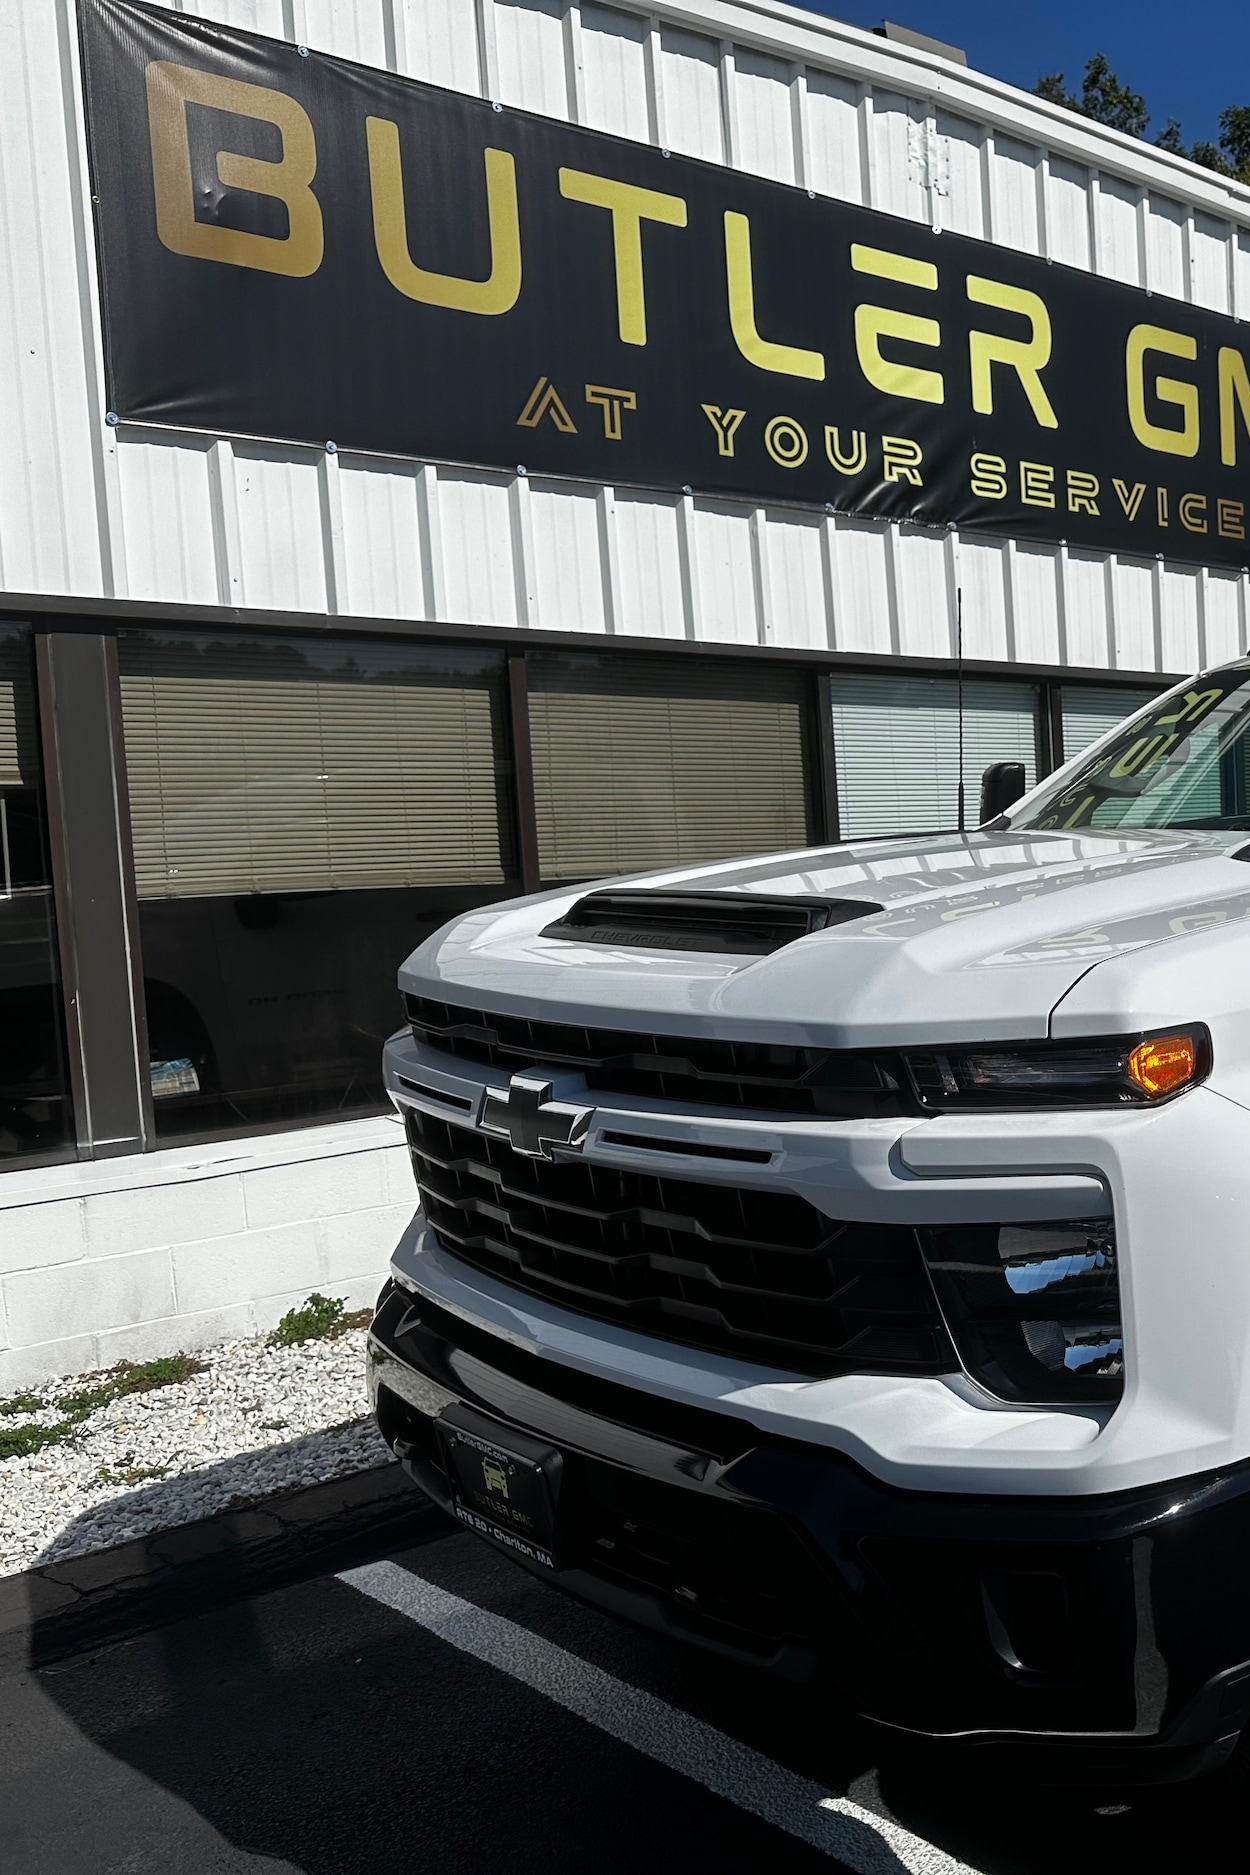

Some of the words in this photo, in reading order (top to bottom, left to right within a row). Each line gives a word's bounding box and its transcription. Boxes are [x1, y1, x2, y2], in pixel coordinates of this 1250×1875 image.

[146, 60, 1058, 429] BUTLER
[517, 376, 637, 440] AT
[701, 404, 923, 487] YOUR
[970, 453, 1246, 540] SERVICE
[591, 930, 704, 948] CHEVROLET
[455, 1507, 474, 1525] RTE
[475, 1518, 488, 1533] 20
[536, 1550, 554, 1568] MA
[473, 1489, 510, 1518] BUTLER
[512, 1509, 535, 1528] GMC
